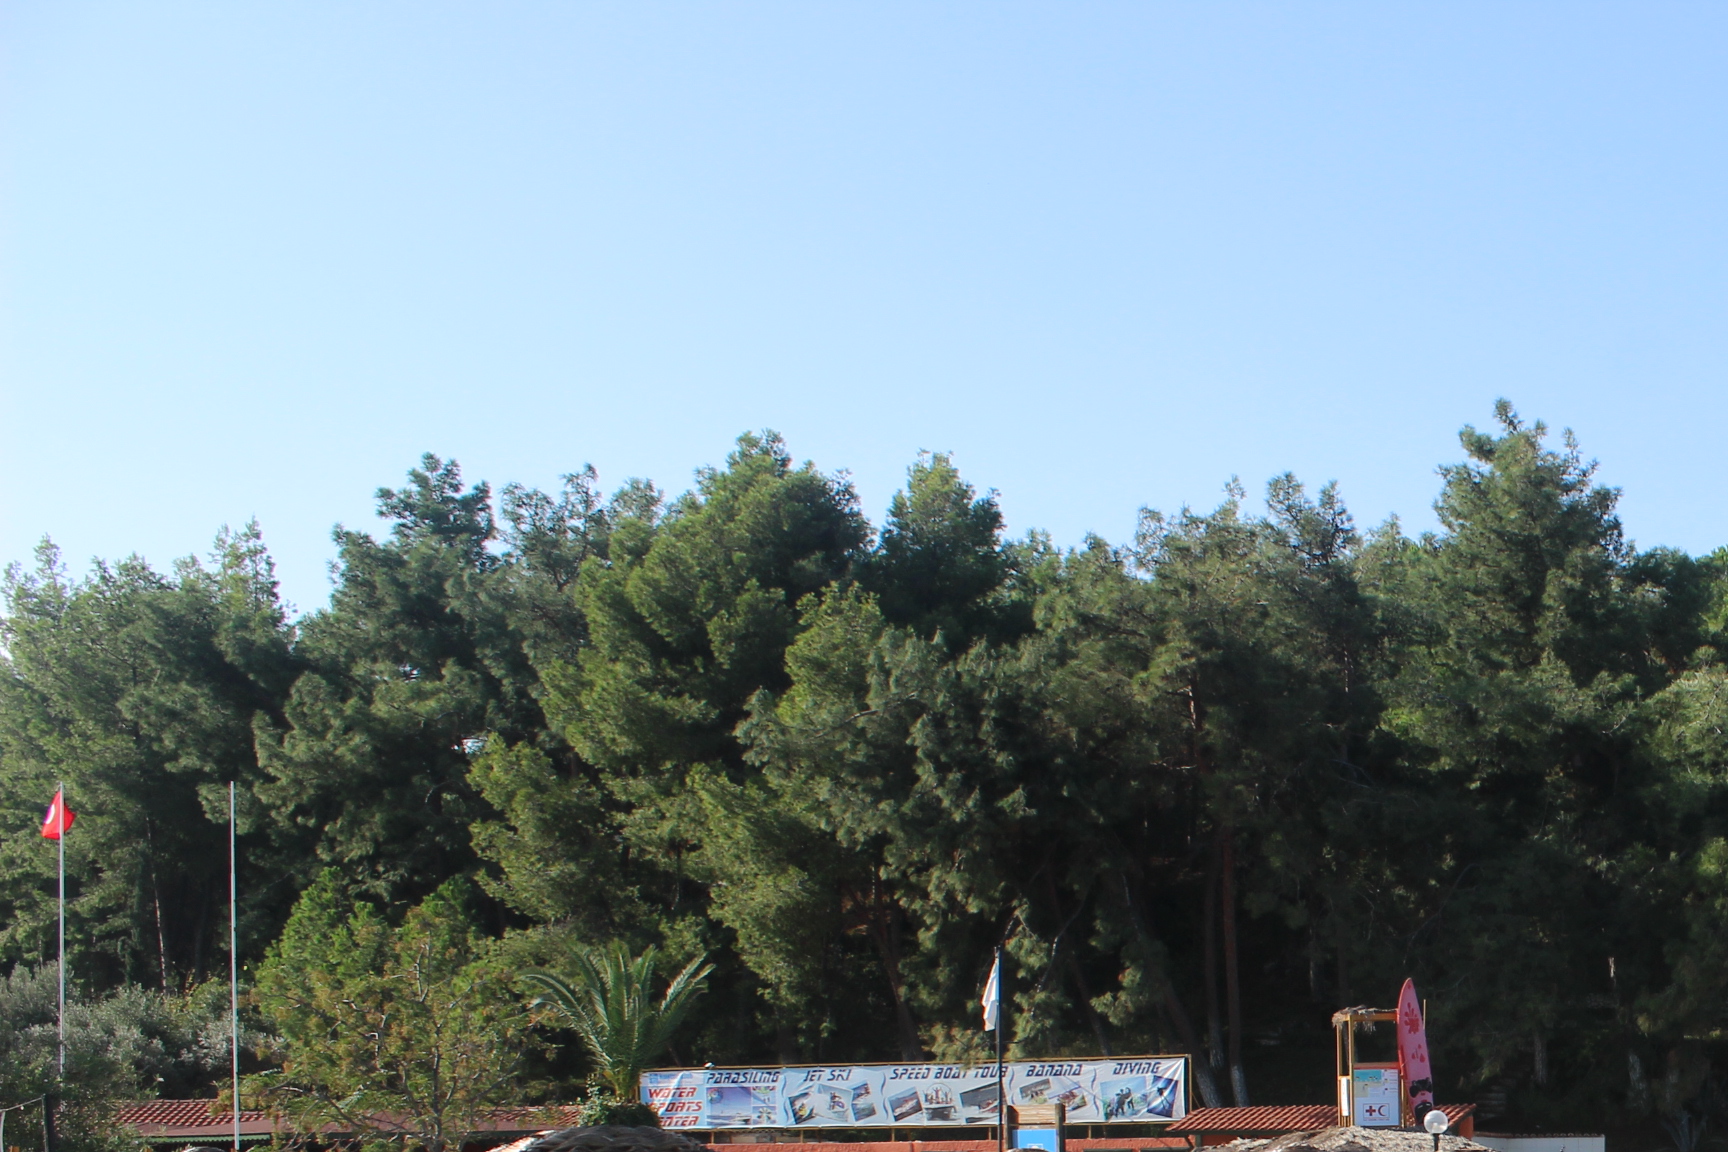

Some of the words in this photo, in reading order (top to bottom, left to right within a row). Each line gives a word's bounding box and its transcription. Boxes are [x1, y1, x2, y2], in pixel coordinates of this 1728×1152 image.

[890, 1068, 930, 1080] SPEED
[1026, 1064, 1083, 1077] BANANA
[1113, 1061, 1161, 1075] DIVING
[707, 1071, 781, 1084] PARASILING
[803, 1070, 826, 1082] JET
[827, 1069, 852, 1081] SKI
[648, 1087, 697, 1099] WATER
